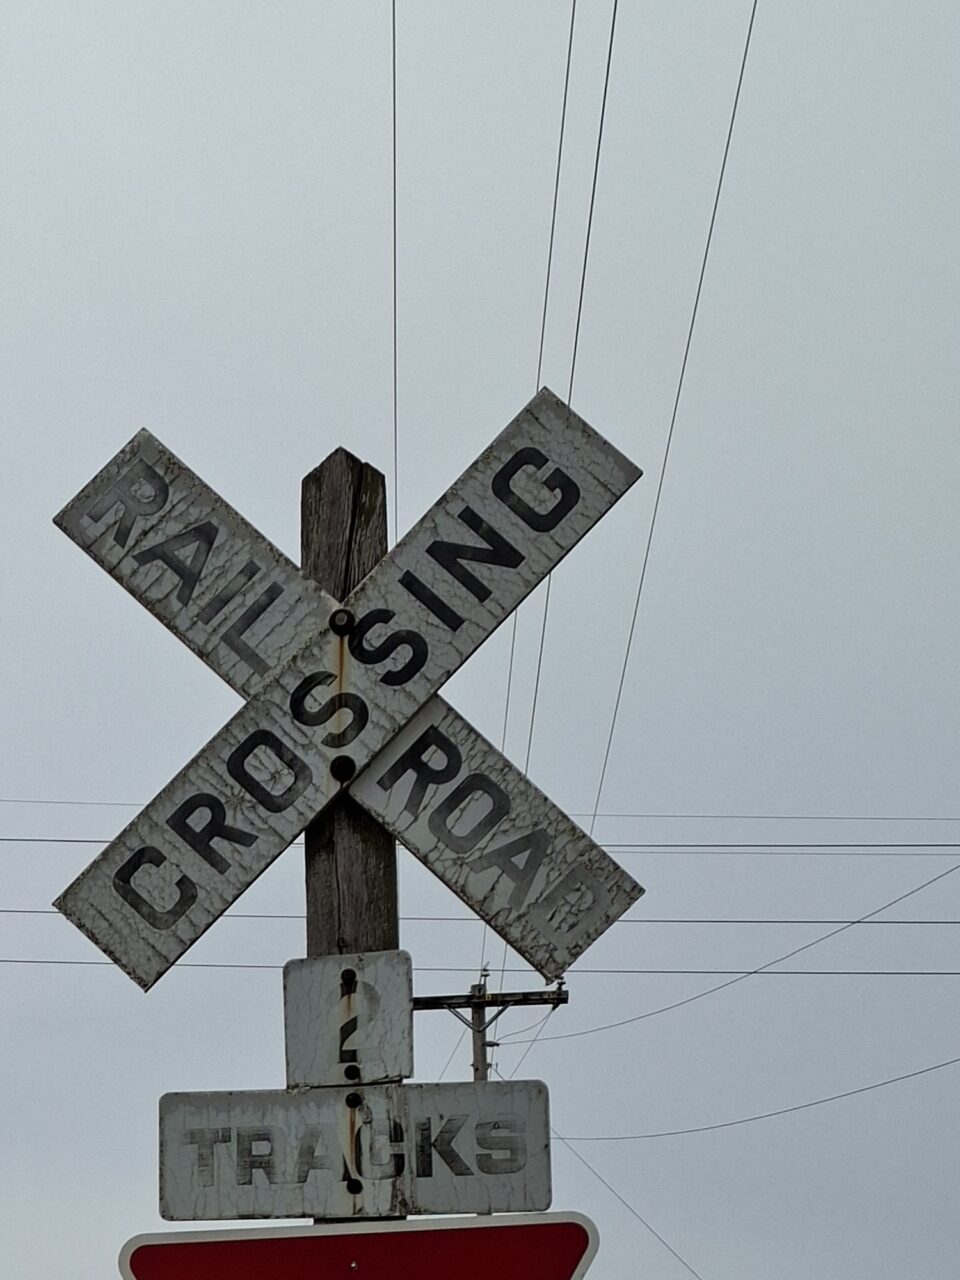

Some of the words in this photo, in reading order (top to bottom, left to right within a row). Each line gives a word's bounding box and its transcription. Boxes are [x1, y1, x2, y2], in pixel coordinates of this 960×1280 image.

[86, 460, 287, 677] RAIL
[377, 725, 608, 948] ROAD
[113, 446, 581, 931] CROSSING
[184, 1113, 527, 1188] TRACKS
